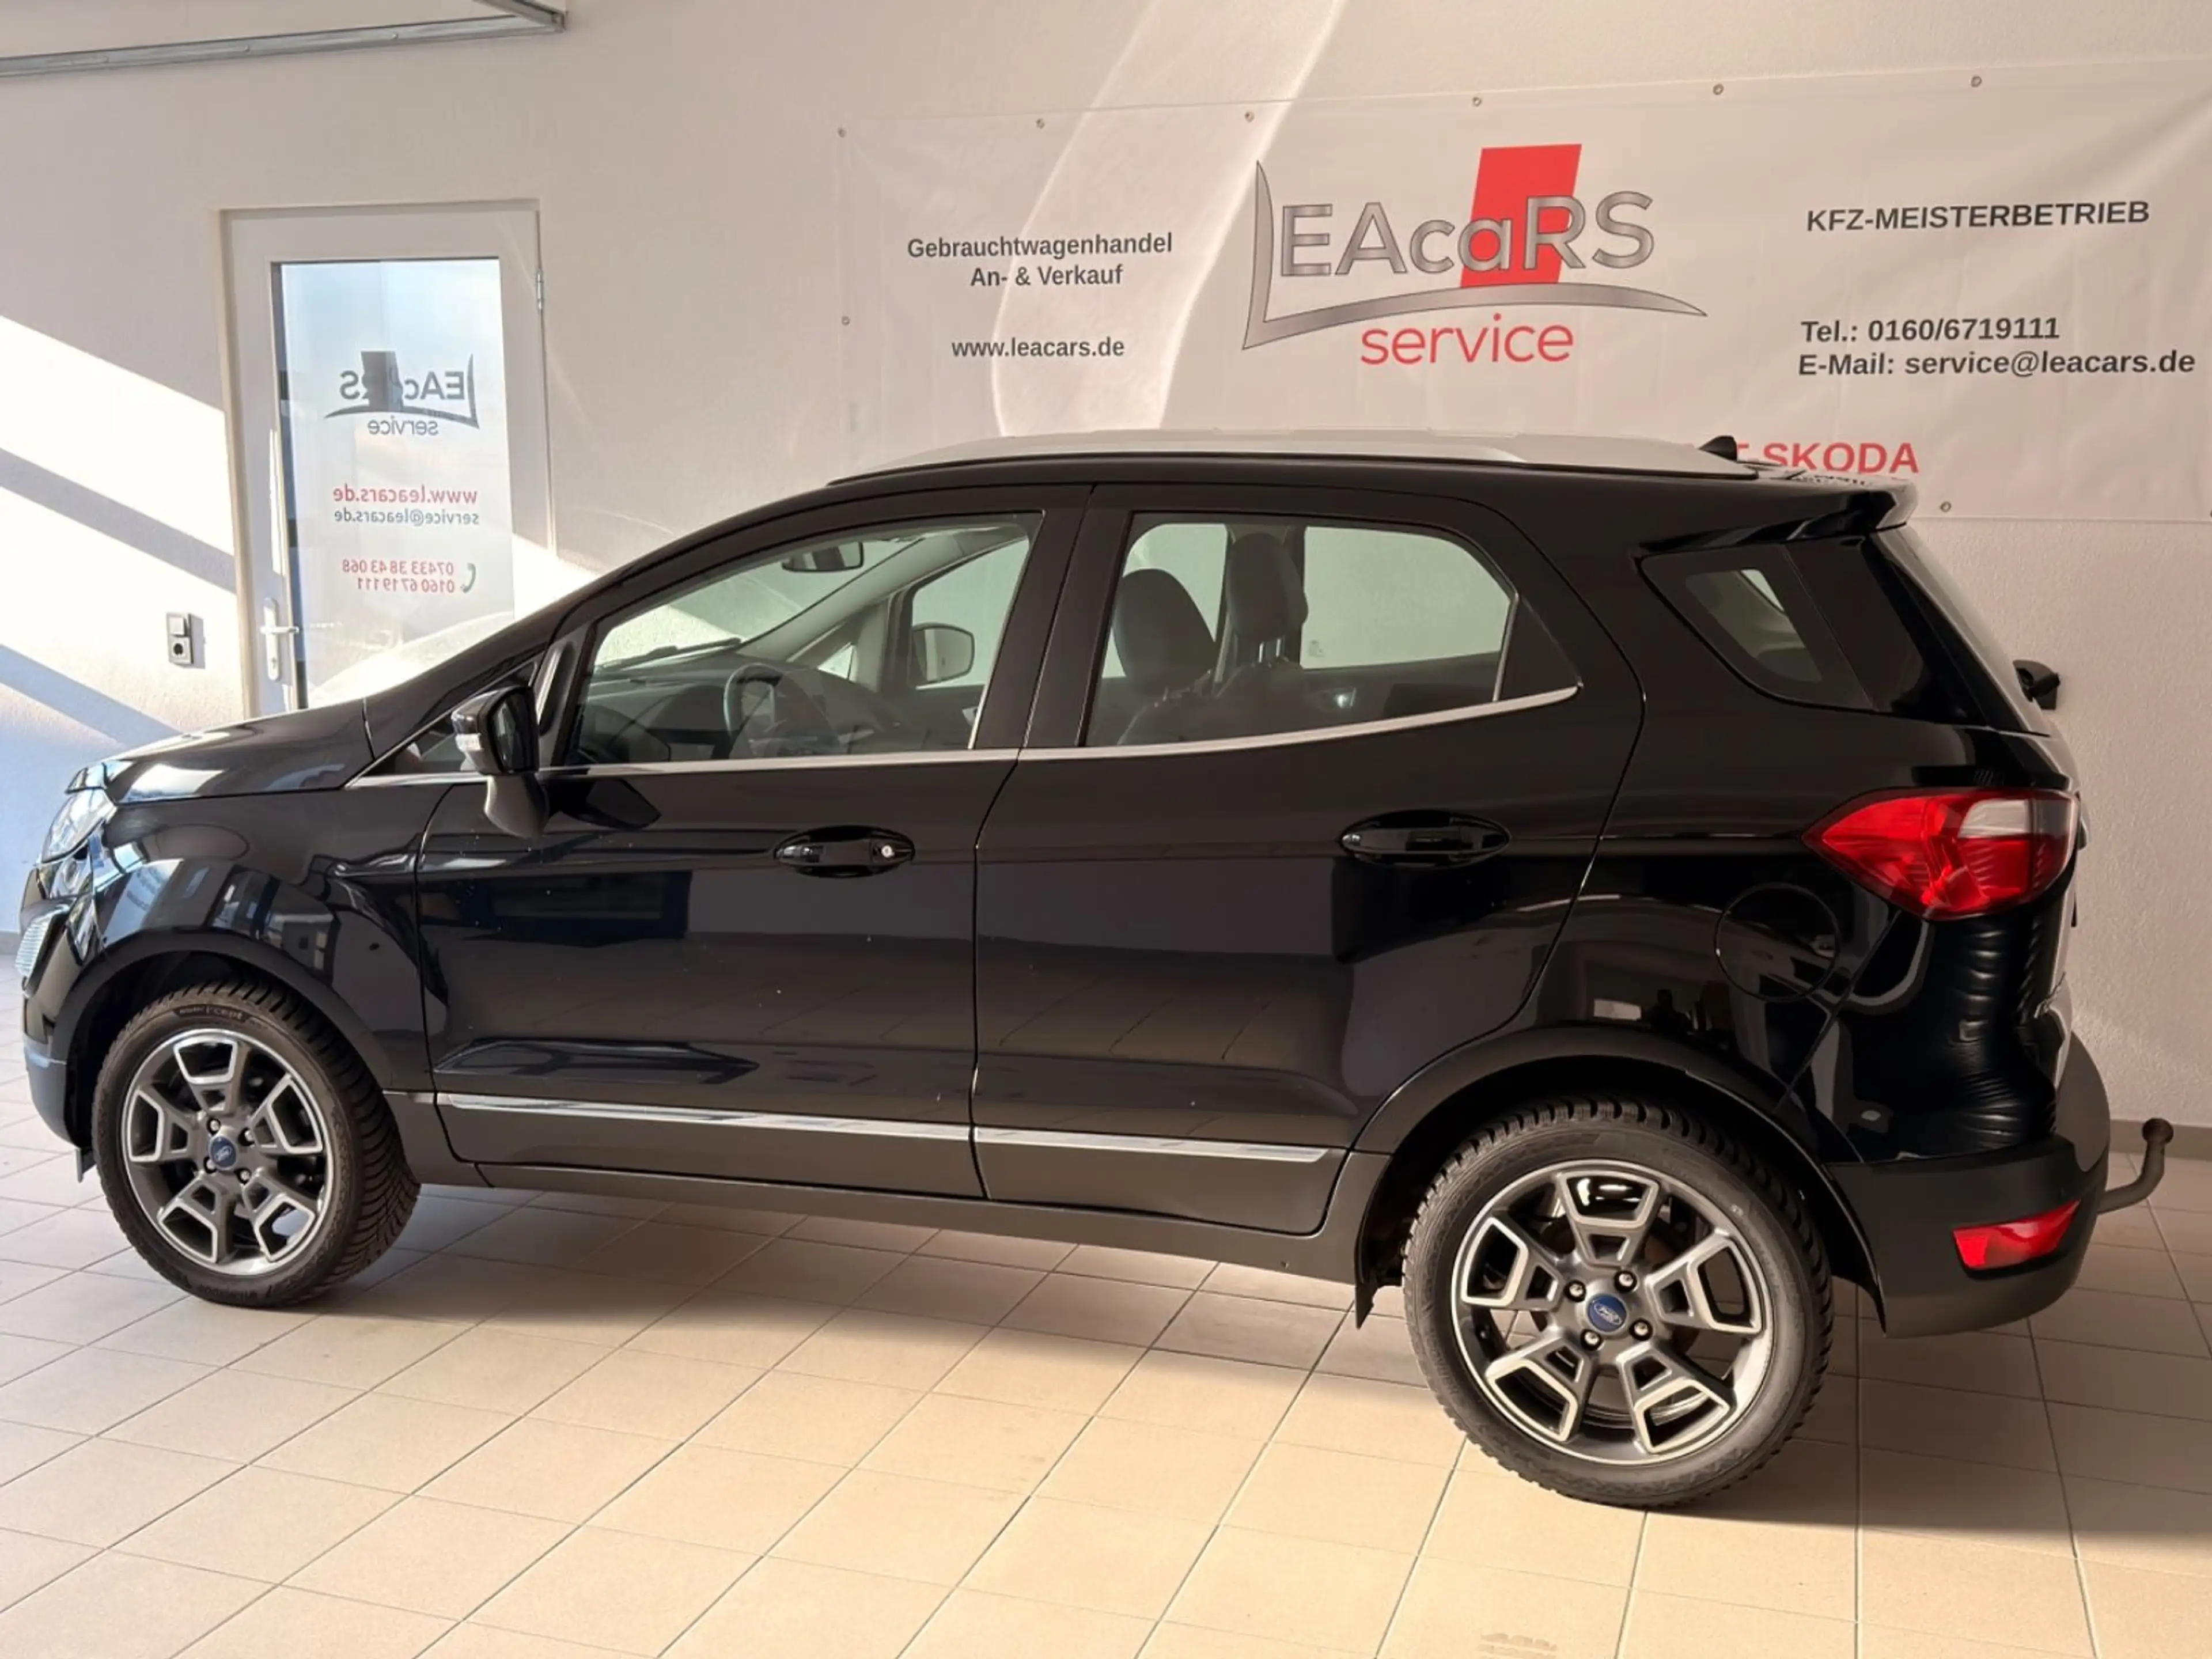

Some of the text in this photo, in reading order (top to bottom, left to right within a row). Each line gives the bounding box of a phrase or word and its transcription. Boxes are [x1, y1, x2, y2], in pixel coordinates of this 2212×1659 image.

[1806, 200, 2150, 232] KFZ-MEISTERBETRIEB
[907, 232, 1173, 260] Gebrauchtwagenhandel
[970, 264, 1124, 287] An- & Verkauf
[1359, 313, 1574, 365] service
[1800, 317, 2061, 343] Tel.: 0160/6719111
[951, 336, 1125, 357] www.leacars.de
[1798, 349, 2196, 378] E-Mail: service@leacars.de
[1763, 442, 1919, 474] SKODA
